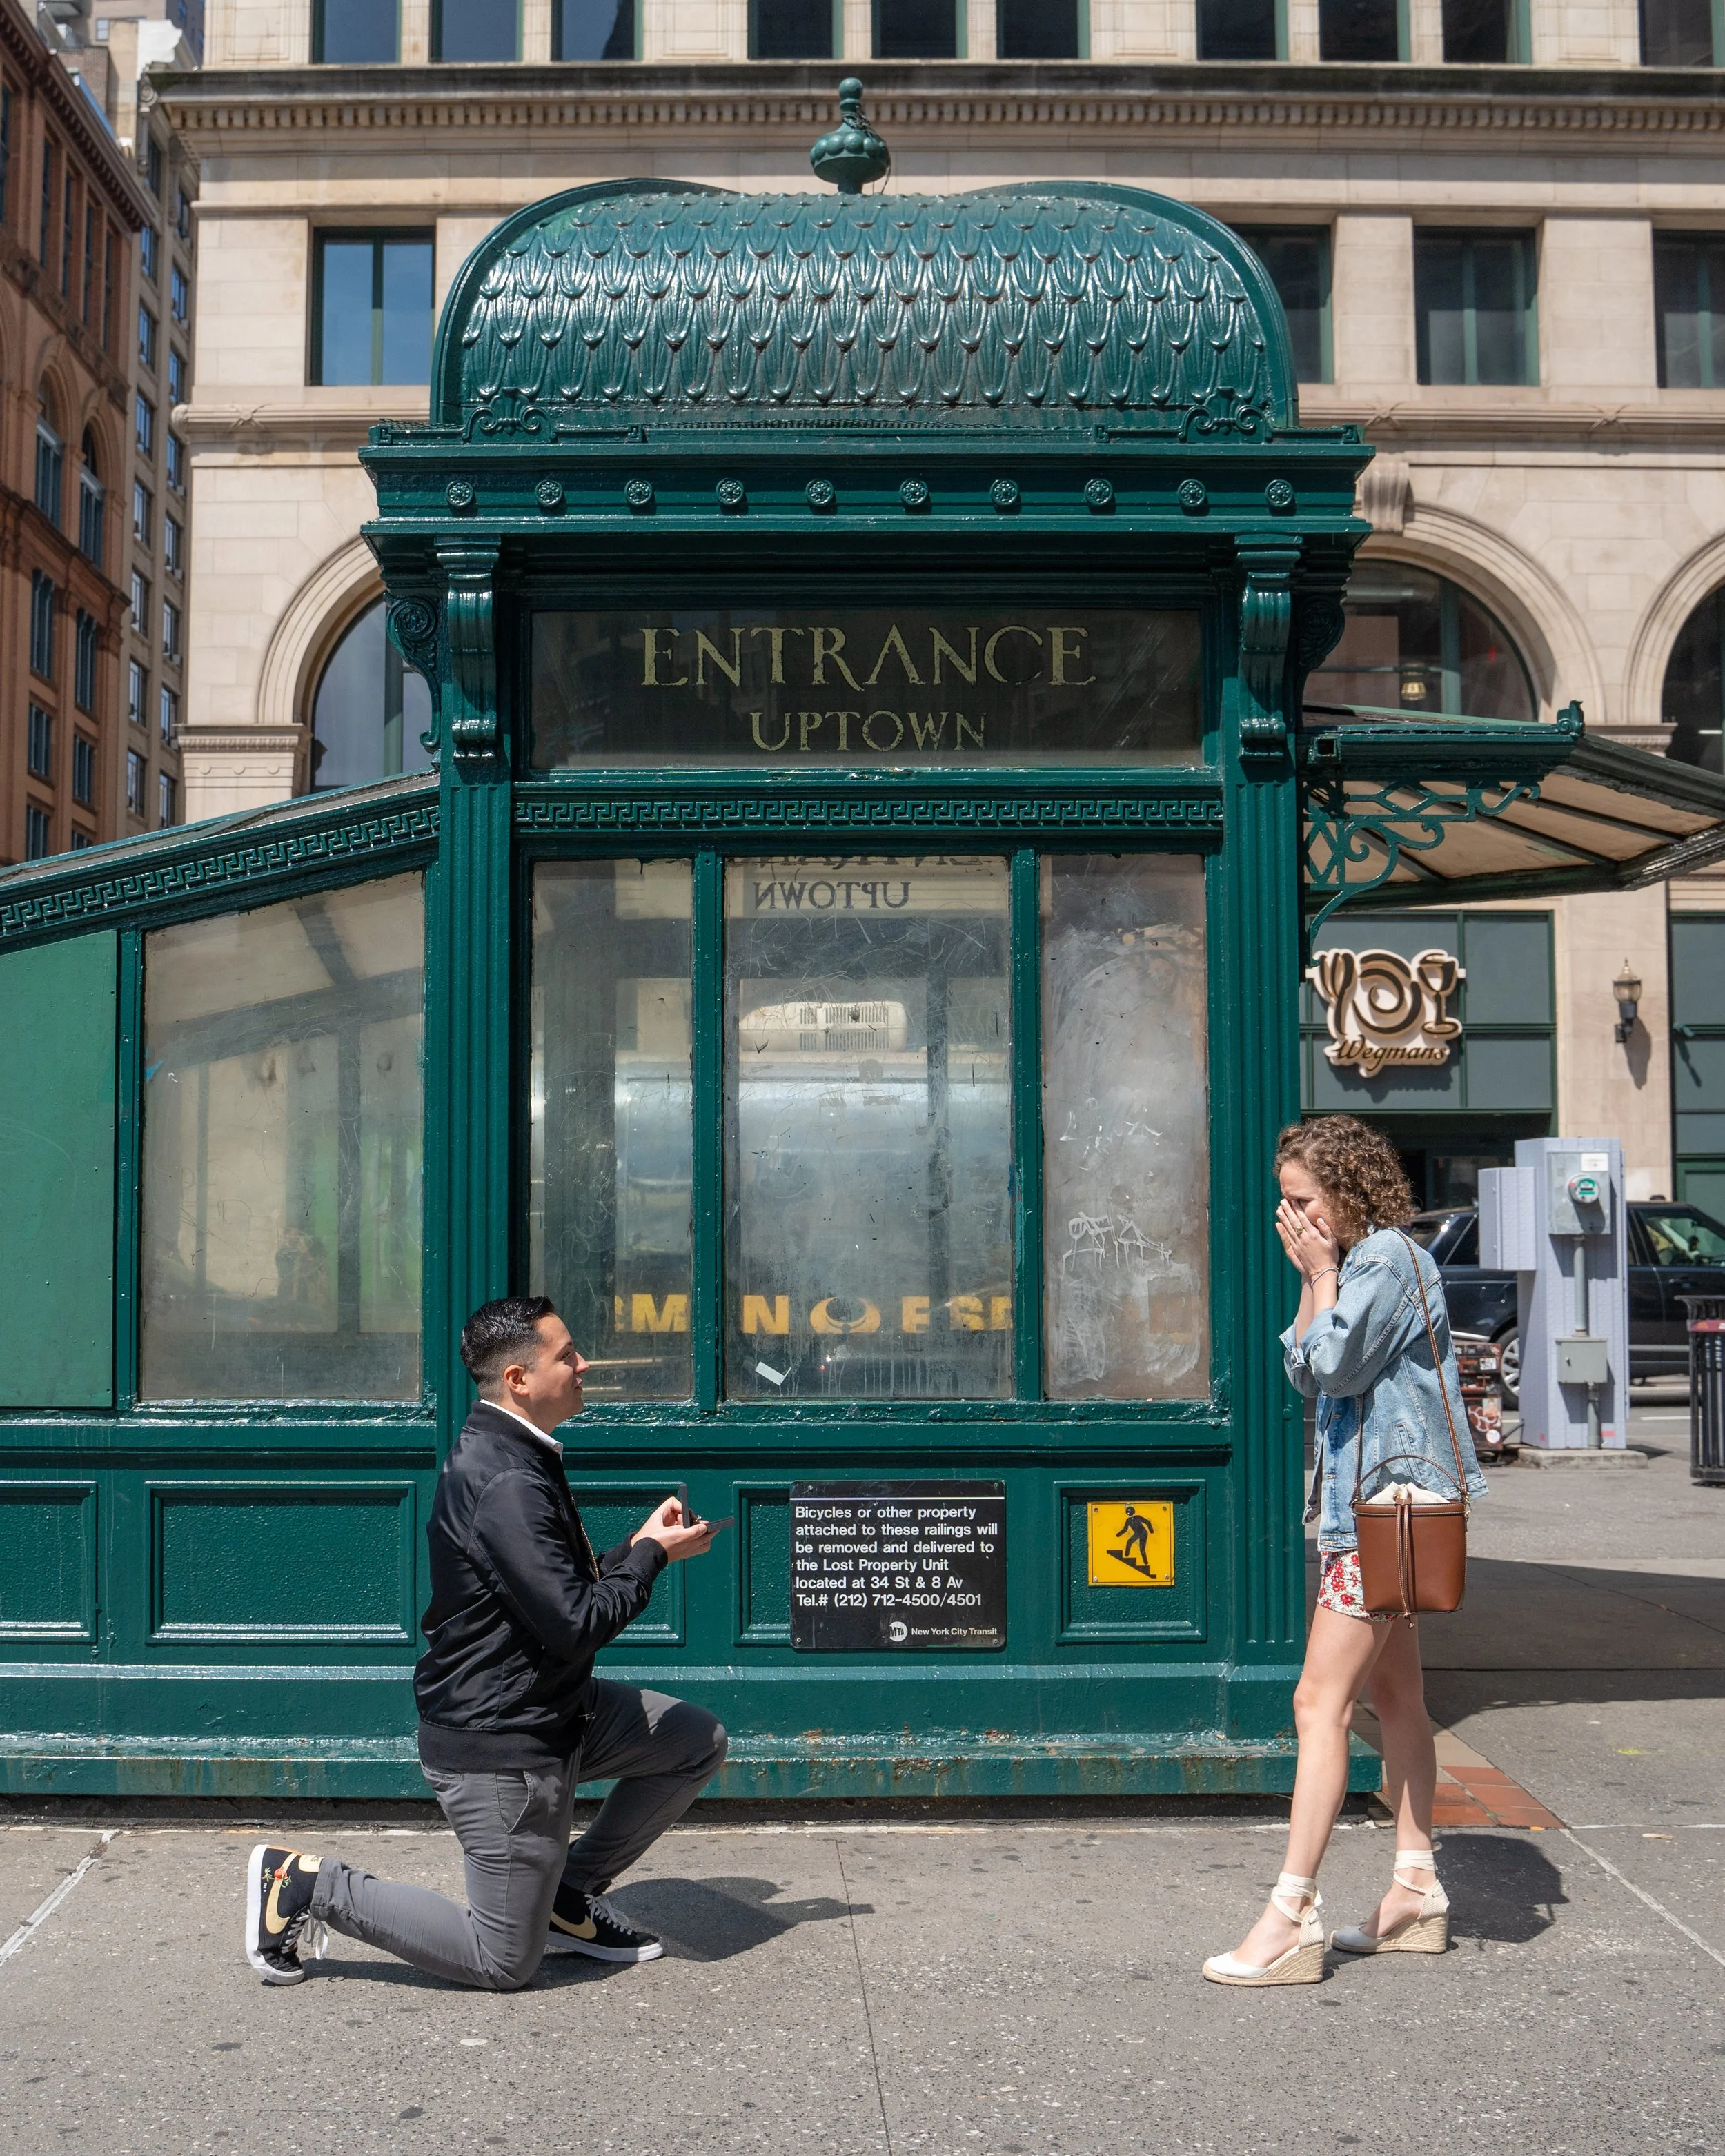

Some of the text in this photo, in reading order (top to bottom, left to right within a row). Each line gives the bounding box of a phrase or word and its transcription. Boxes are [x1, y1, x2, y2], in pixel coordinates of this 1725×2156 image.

[639, 624, 1096, 691] ENTRANCE
[750, 711, 985, 751] UPTOWN
[1332, 1035, 1449, 1071] Wegmans
[795, 1506, 976, 1520] Bicycles or other property
[796, 1523, 998, 1538] attached to these railings will
[796, 1541, 994, 1554] be removed and delivered to
[796, 1559, 949, 1573] the Lost Property Unit
[796, 1576, 963, 1589] located at 34 St & 8 Av
[796, 1593, 981, 1608] Tel.# (212) 712-4500/4501
[911, 1628, 998, 1637] New York City Transit
